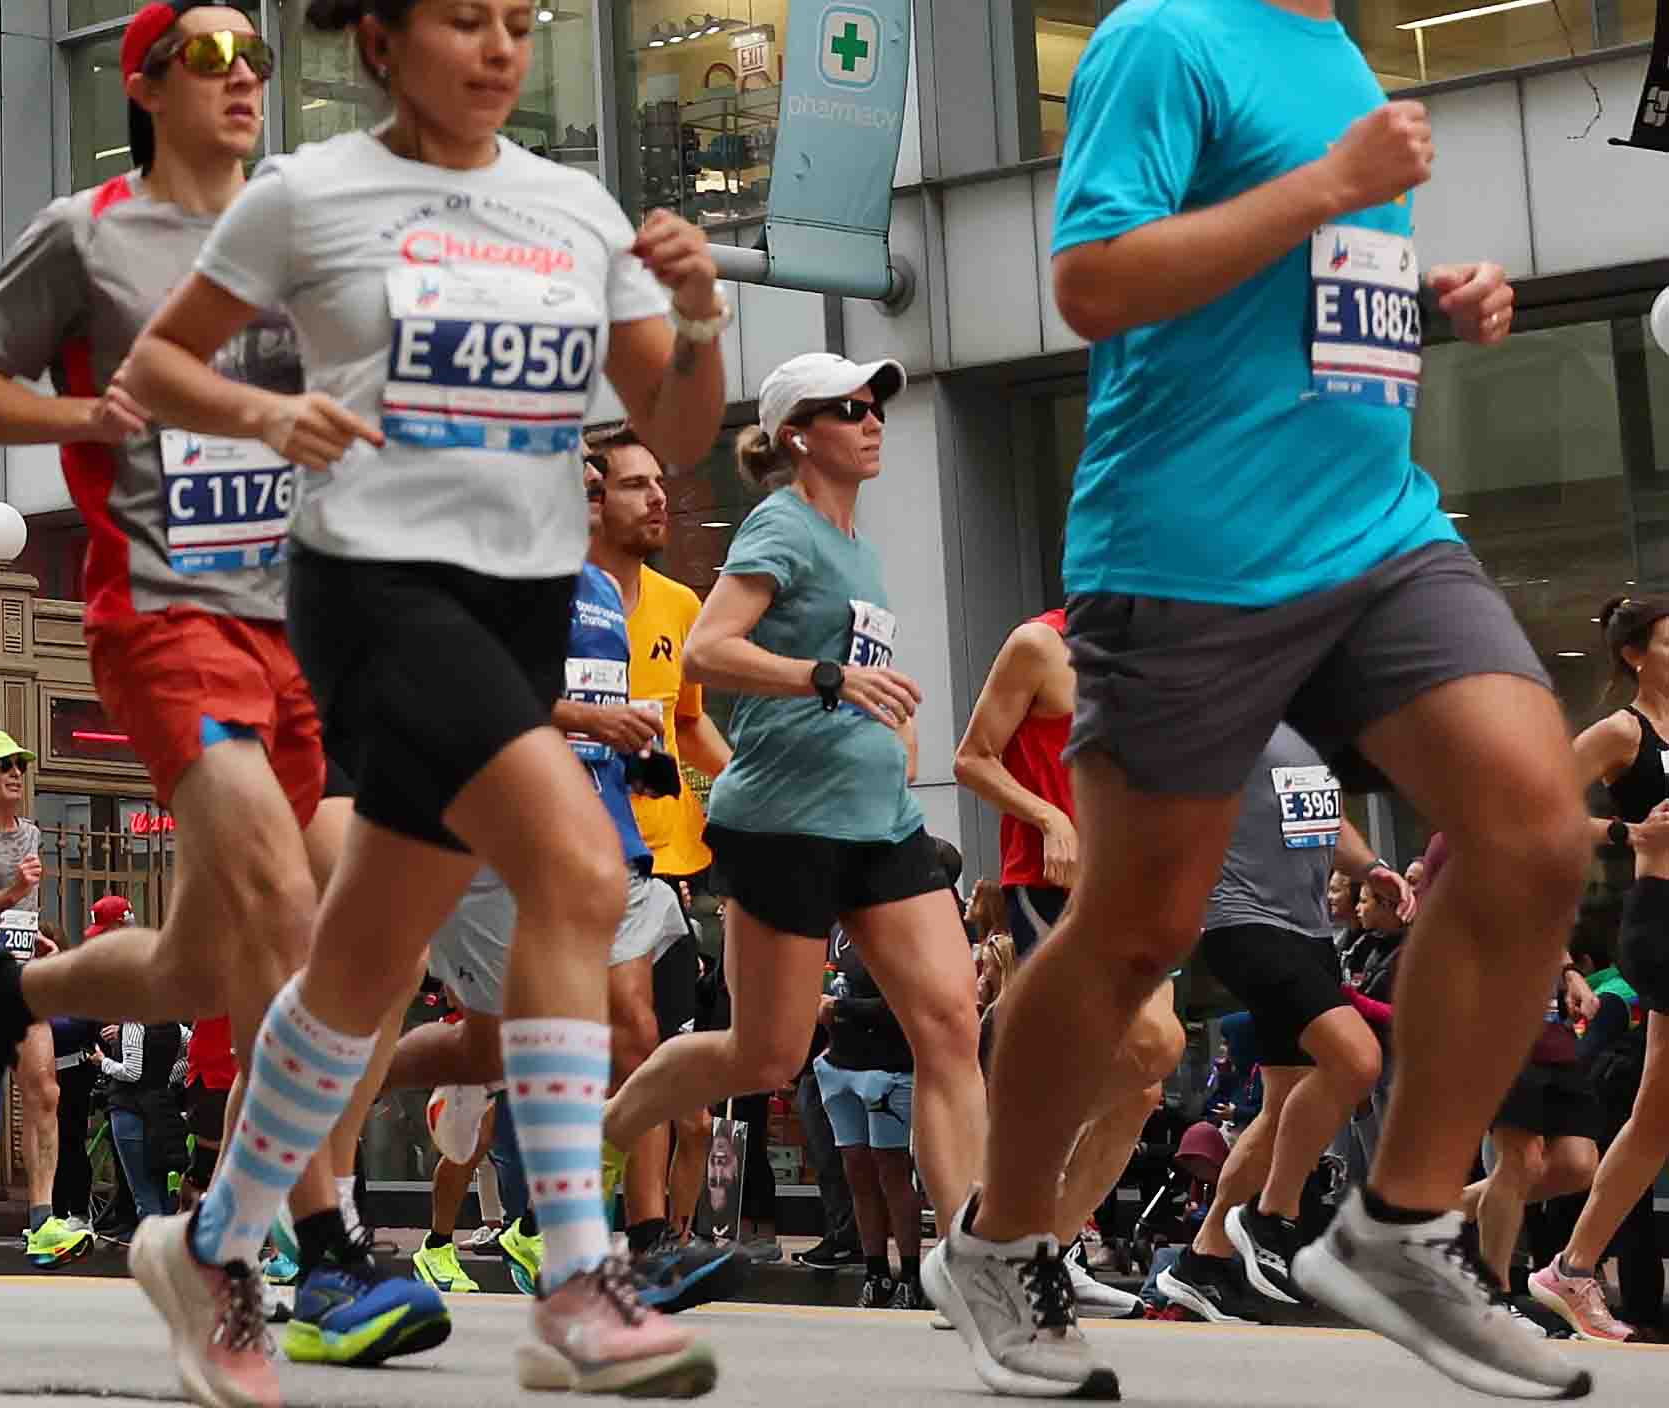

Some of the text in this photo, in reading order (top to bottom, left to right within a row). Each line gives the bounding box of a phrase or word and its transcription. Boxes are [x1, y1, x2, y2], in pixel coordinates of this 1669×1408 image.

[742, 45, 764, 67] EXIT
[789, 92, 902, 136] pharmacy
[401, 230, 575, 276] Chicago
[1316, 284, 1341, 334] E
[395, 319, 597, 388] E 4950
[169, 478, 195, 520] C
[1280, 789, 1340, 820] E 3961
